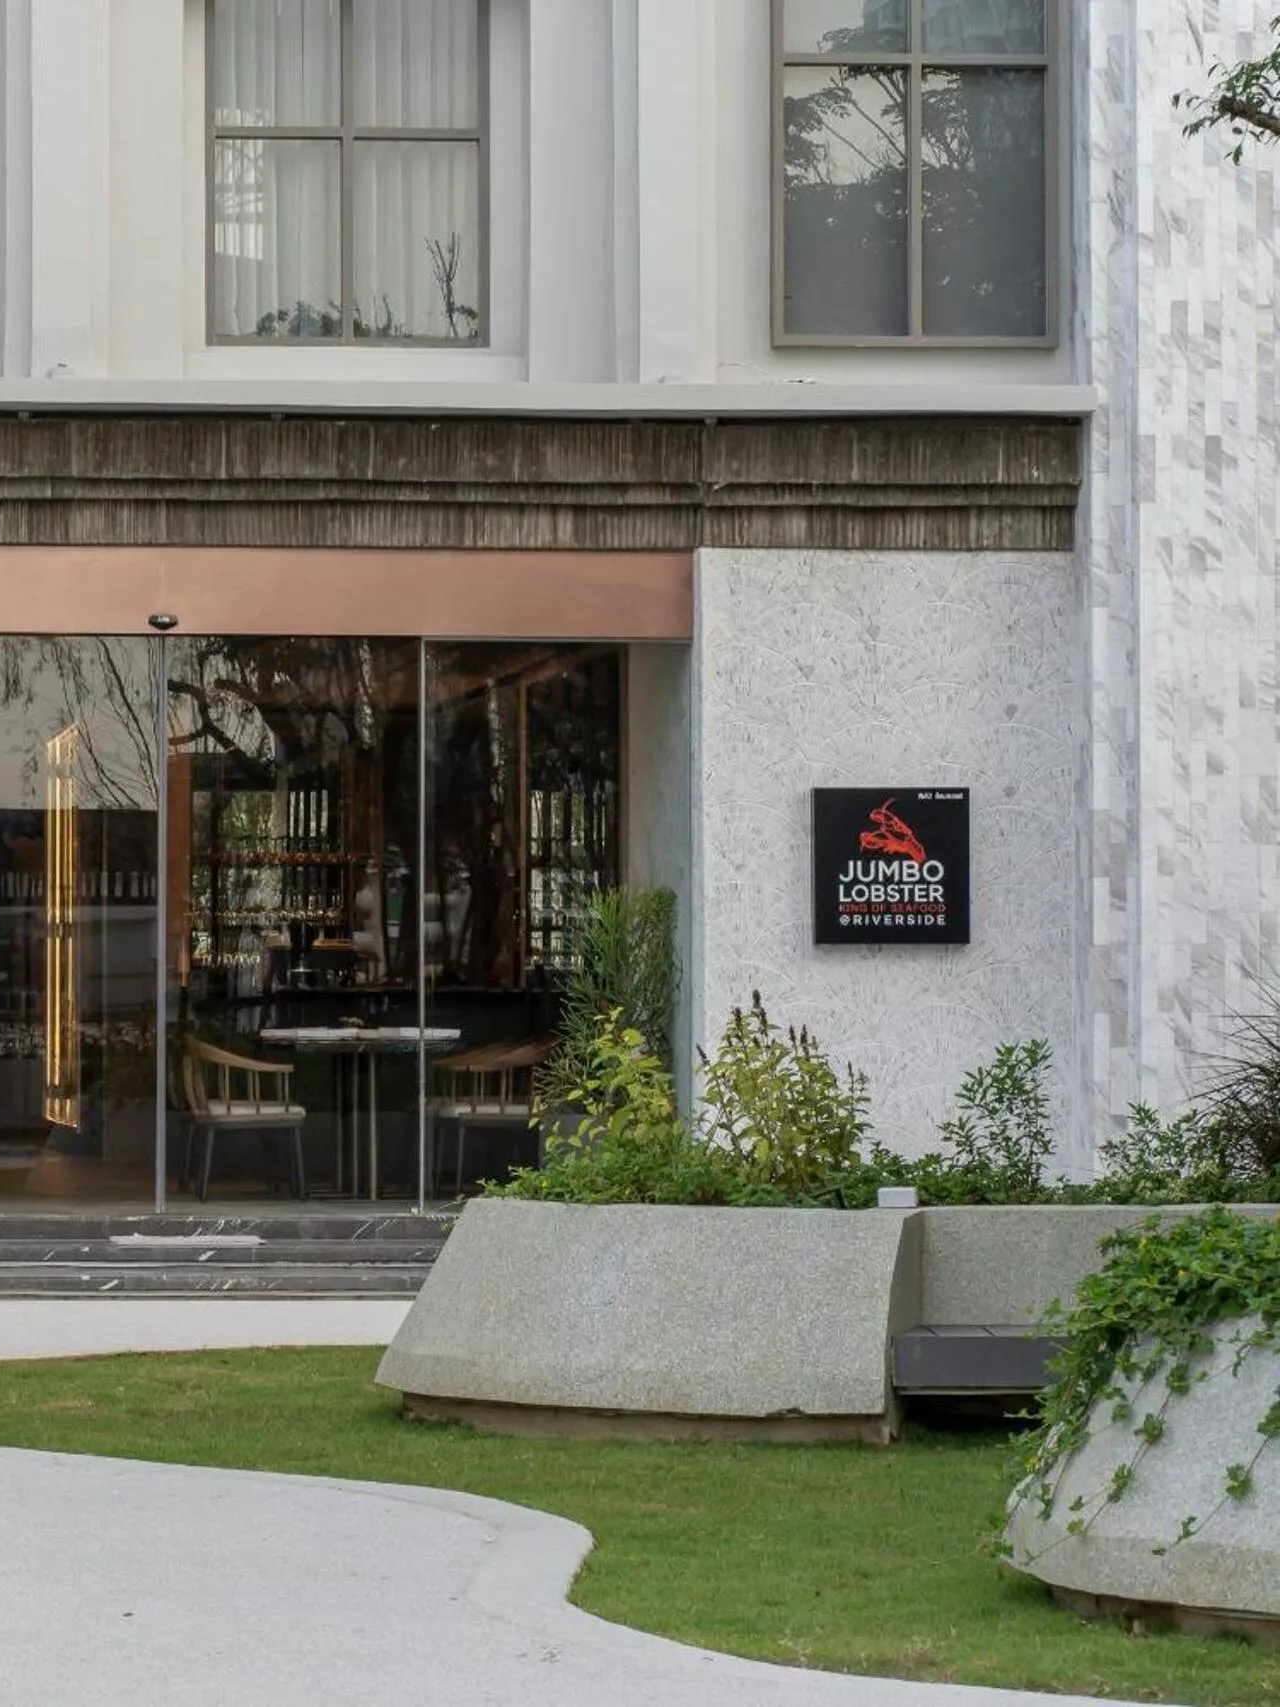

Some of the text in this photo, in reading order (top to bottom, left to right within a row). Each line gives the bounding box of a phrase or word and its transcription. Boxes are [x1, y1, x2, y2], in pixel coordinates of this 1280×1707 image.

[839, 860, 945, 882] JUMBO
[839, 884, 944, 902] LOBSTER
[839, 904, 946, 913] KING OF SEAFOOD
[839, 914, 946, 926] @RIVERSIDE
